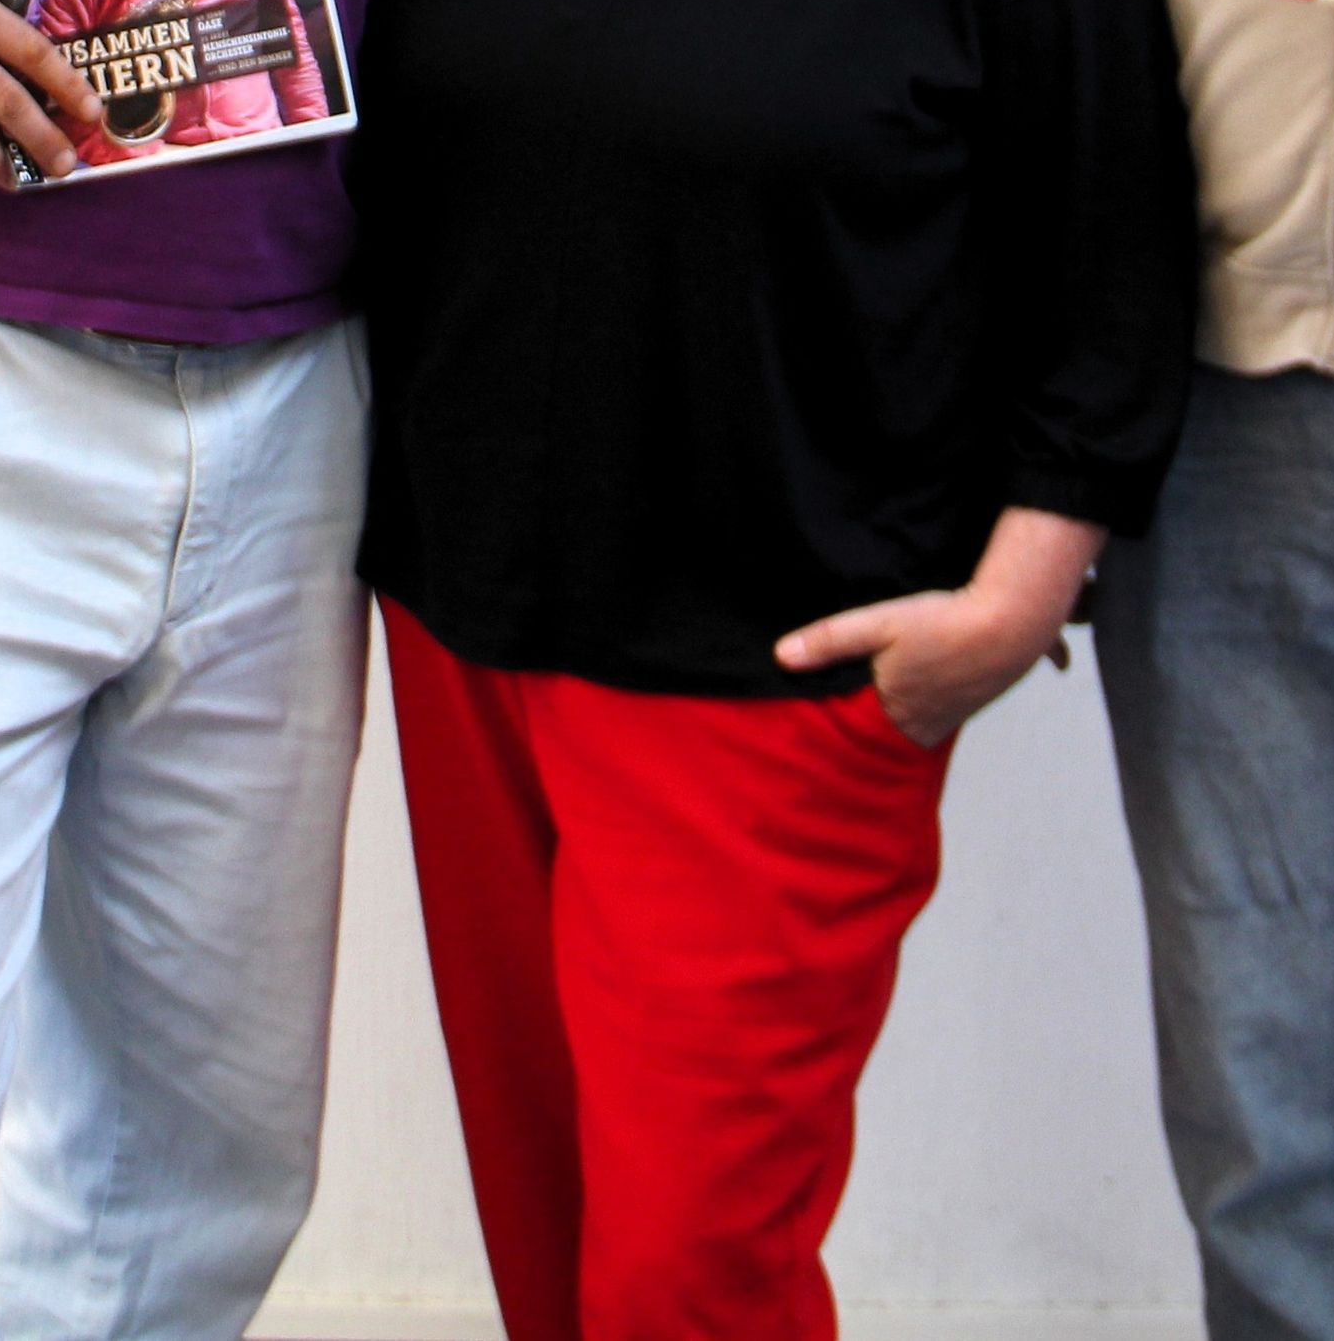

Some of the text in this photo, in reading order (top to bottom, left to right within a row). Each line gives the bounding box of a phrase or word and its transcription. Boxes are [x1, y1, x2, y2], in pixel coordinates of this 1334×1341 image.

[198, 17, 223, 31] OASE
[204, 44, 255, 62] ORCHESTER
[84, 45, 198, 98] IERN
